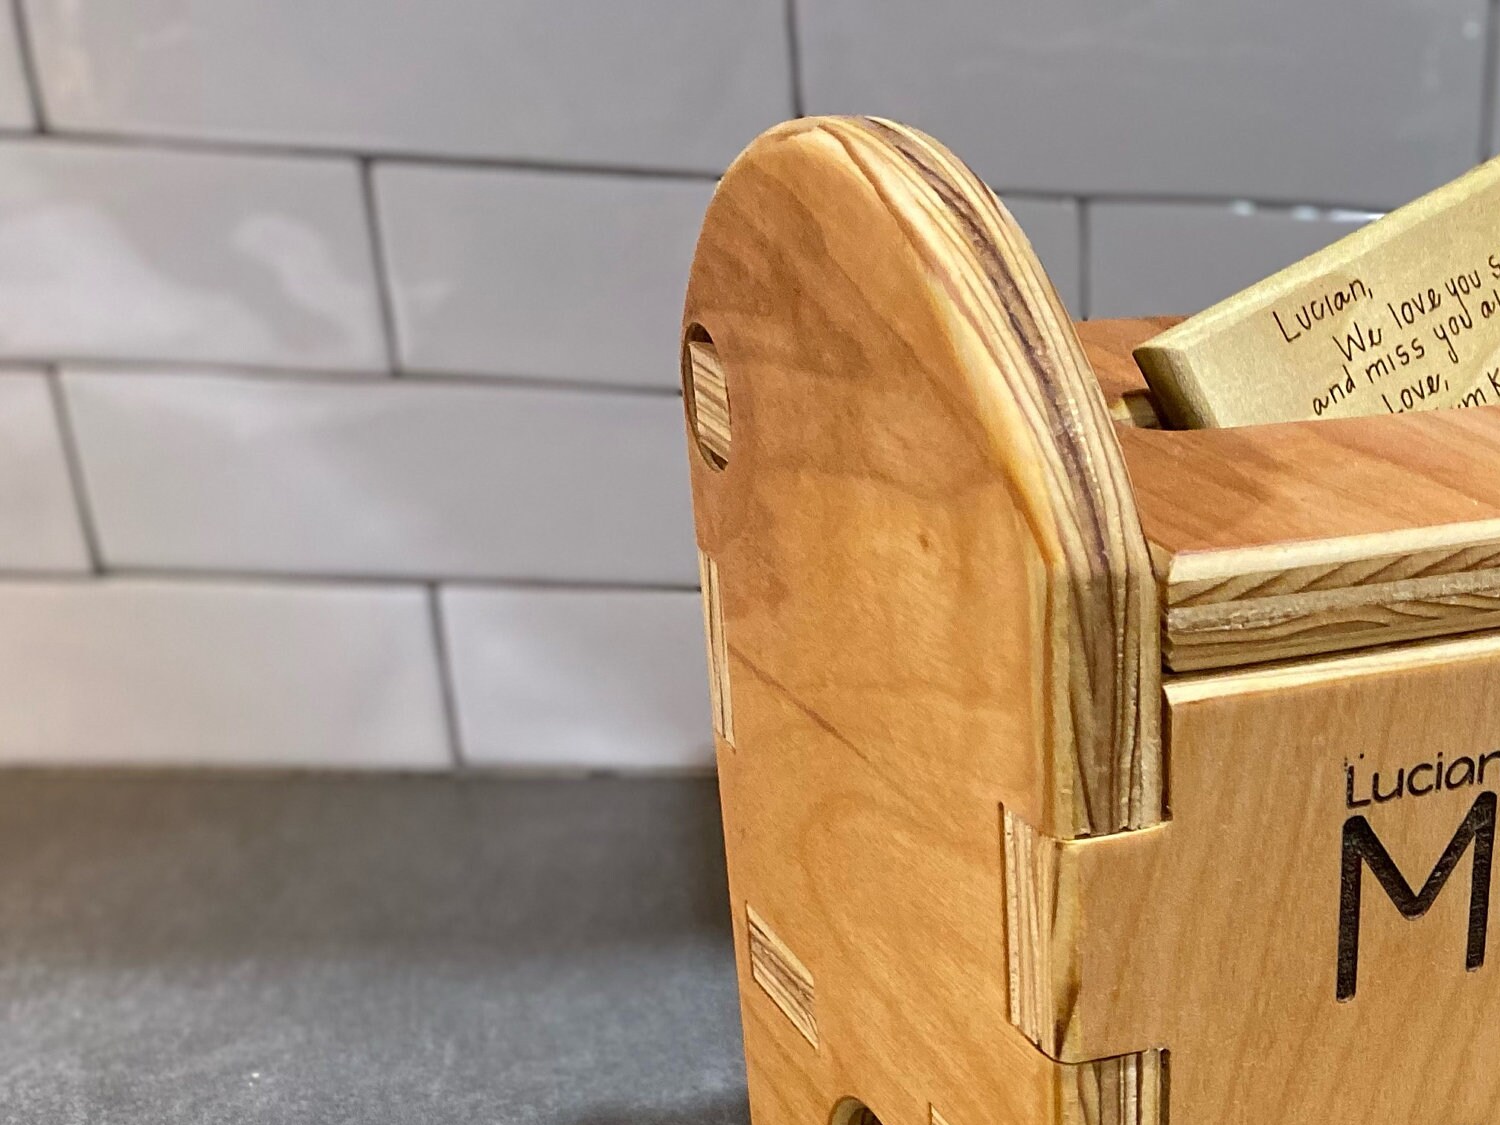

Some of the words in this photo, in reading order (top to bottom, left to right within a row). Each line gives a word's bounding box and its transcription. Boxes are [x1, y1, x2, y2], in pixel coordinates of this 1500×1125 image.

[1273, 277, 1373, 342] Lucian,
[1333, 322, 1383, 361] We
[1389, 288, 1442, 329] love
[1445, 271, 1482, 310] you
[1313, 366, 1355, 416] and
[1365, 342, 1425, 382] miss
[1433, 313, 1472, 364] you
